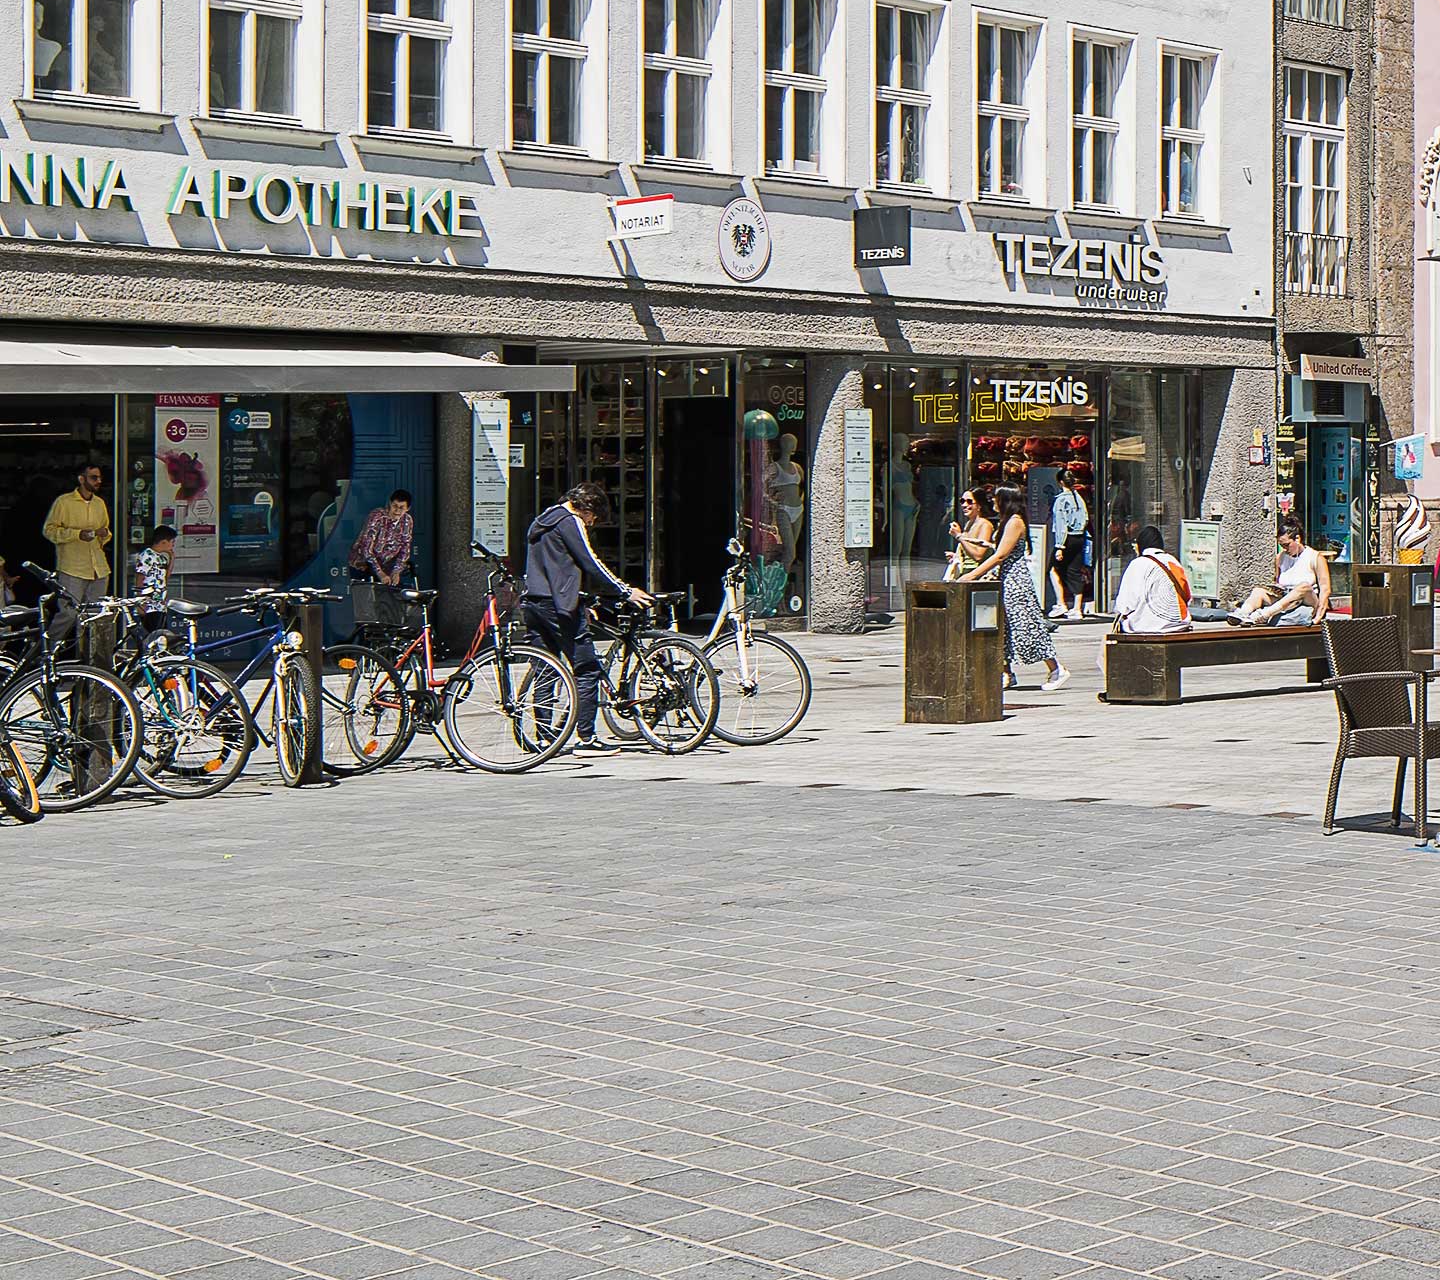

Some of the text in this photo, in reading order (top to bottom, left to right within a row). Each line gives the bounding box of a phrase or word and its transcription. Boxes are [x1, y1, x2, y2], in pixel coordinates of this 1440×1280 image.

[166, 165, 483, 238] APOTHEKE
[621, 214, 665, 230] NOTARIAT
[732, 260, 756, 275] NOTAR
[1076, 283, 1167, 303] underwear
[1312, 362, 1372, 377] United Coffees
[158, 394, 209, 405] FEMANNOSE
